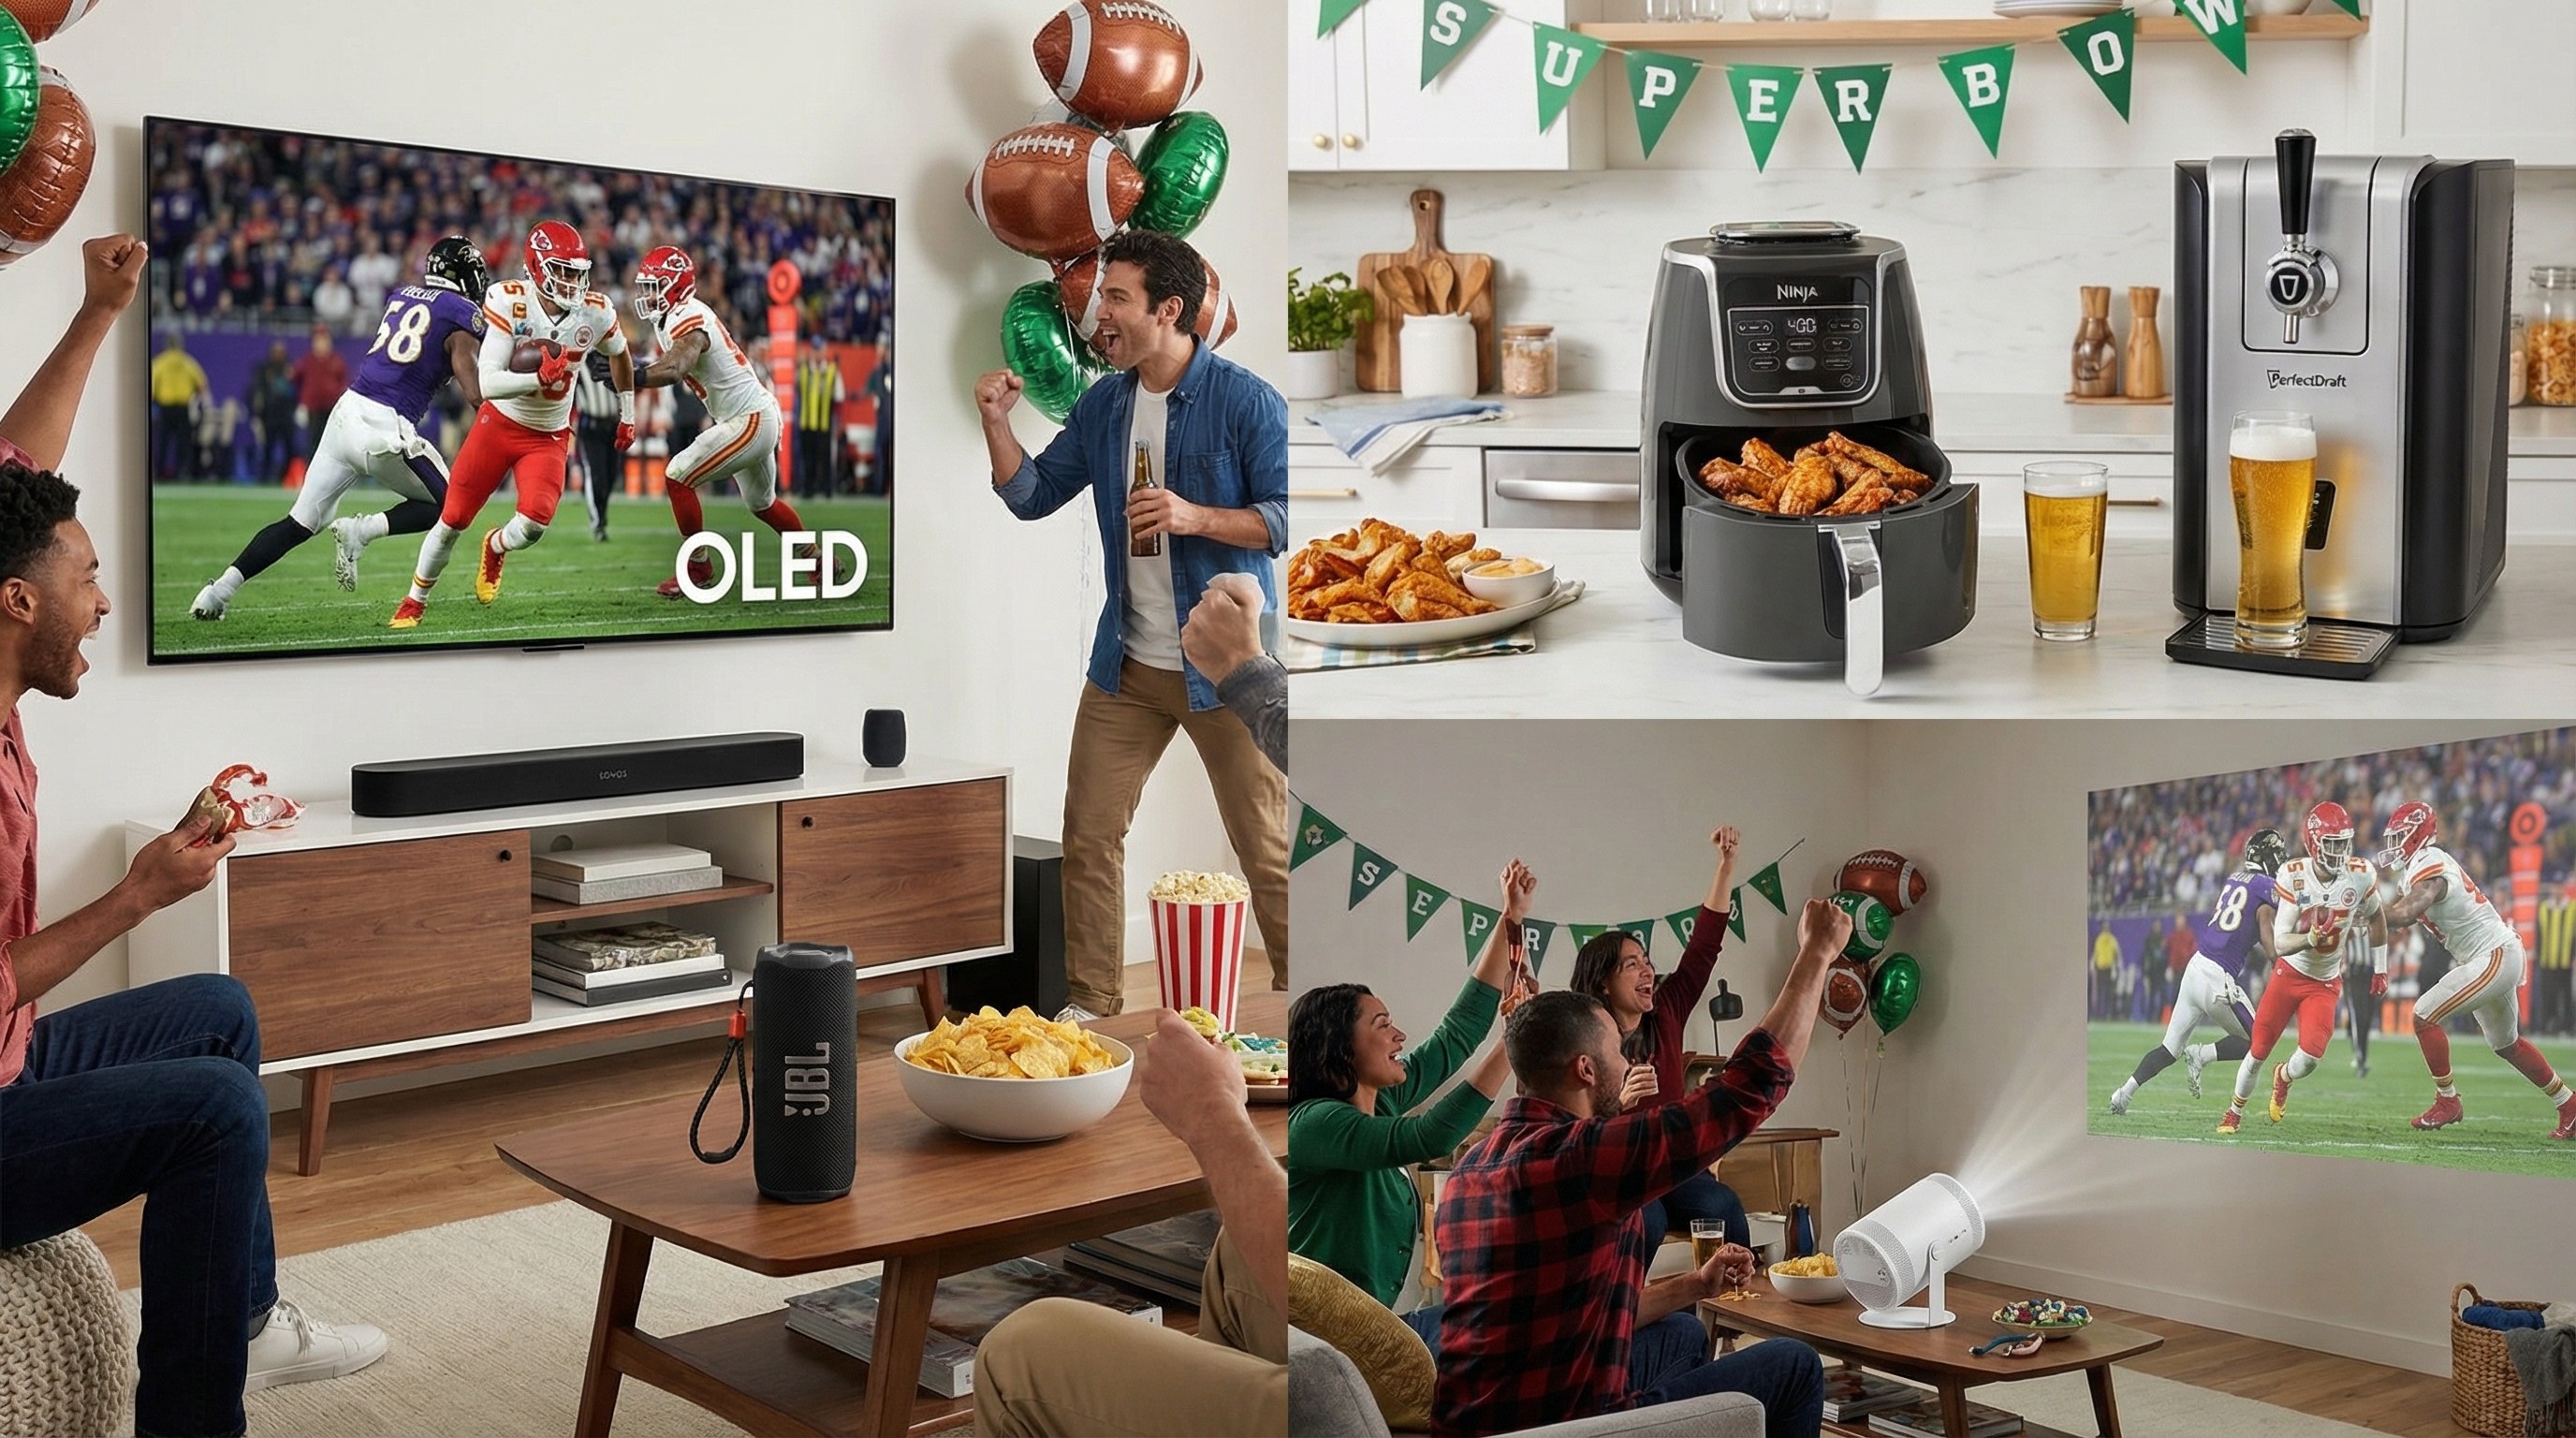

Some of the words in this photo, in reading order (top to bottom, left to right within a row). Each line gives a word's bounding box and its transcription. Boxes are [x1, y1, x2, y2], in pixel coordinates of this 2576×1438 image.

[1429, 1, 1872, 123] SUPER
[1777, 285, 1819, 303] NINJA
[366, 301, 432, 364] 58
[675, 530, 869, 604] OLED
[2208, 884, 2248, 932] 58
[784, 1041, 830, 1117] JBL
